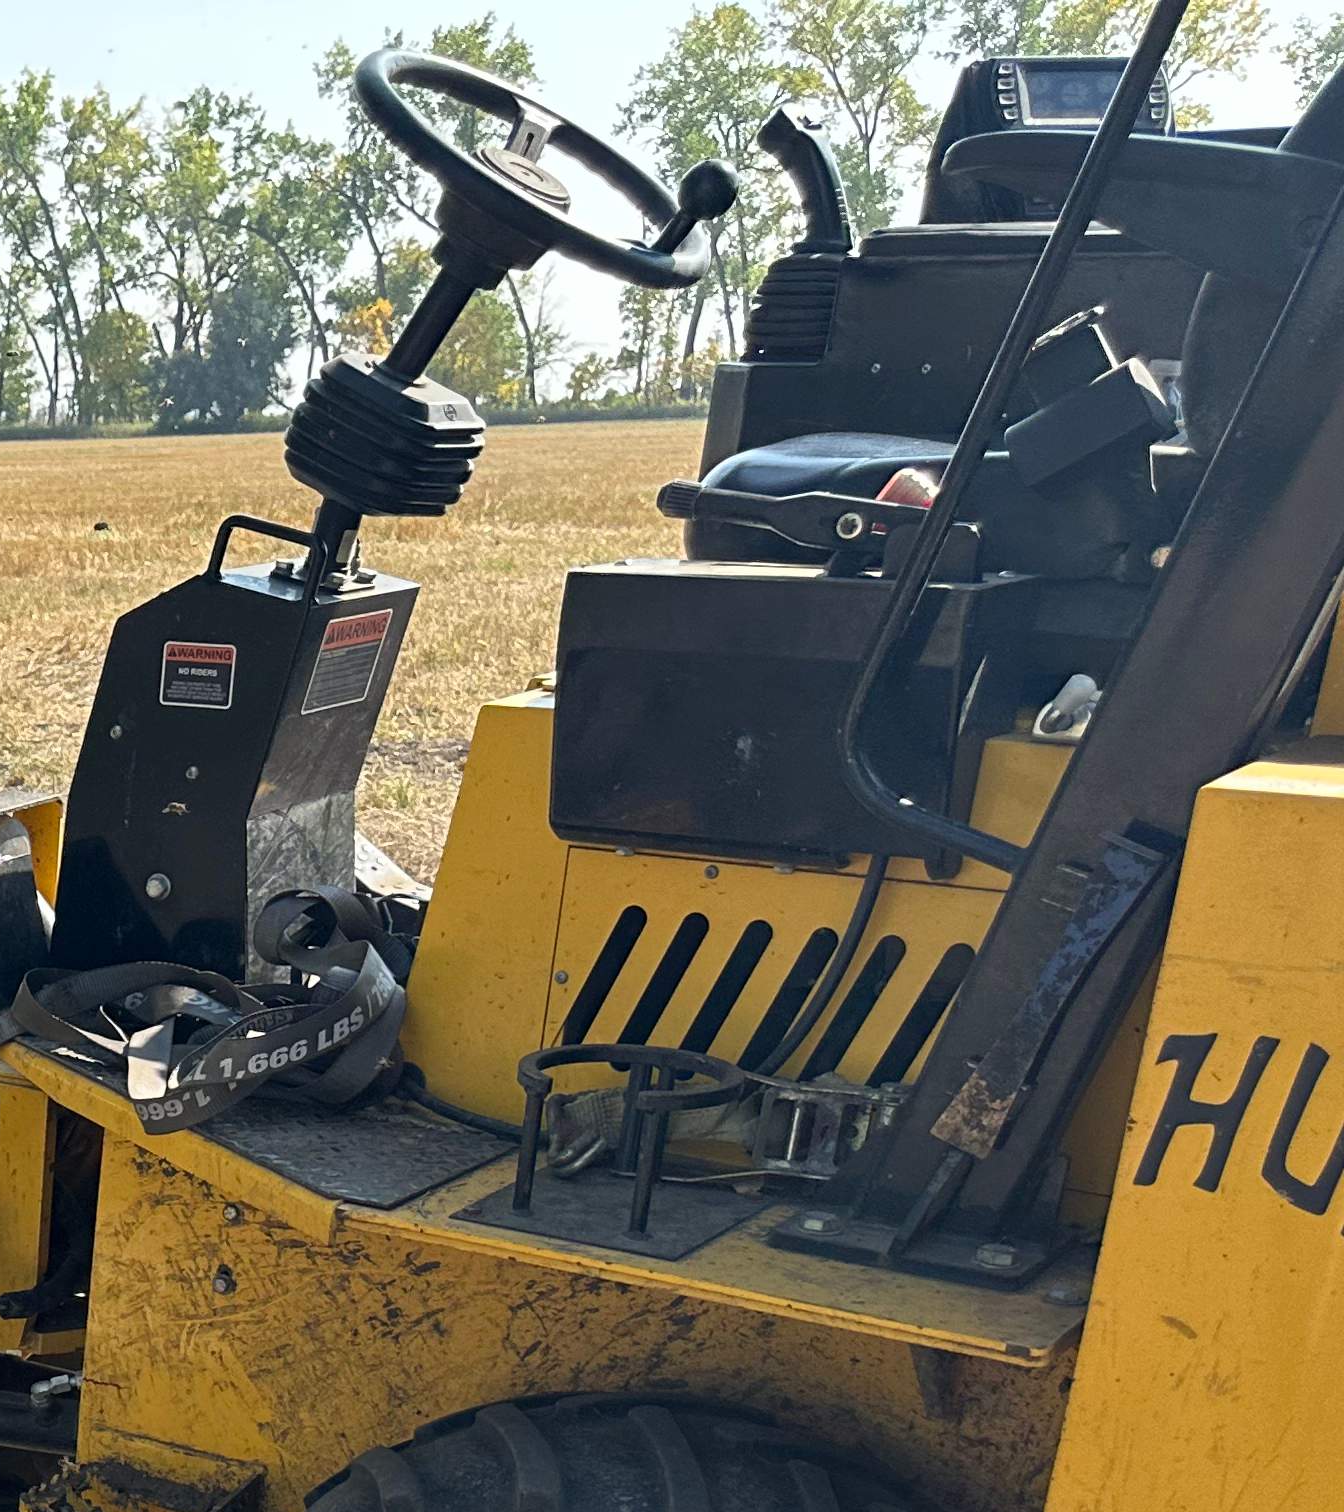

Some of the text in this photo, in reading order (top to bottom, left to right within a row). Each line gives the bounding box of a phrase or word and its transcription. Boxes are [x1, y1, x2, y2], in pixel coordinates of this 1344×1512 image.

[334, 617, 387, 641] WARNING
[176, 648, 231, 660] WARNING
[219, 1039, 308, 1080] 1,666
[317, 1006, 364, 1053] LBS
[1133, 1033, 1344, 1217] HU
